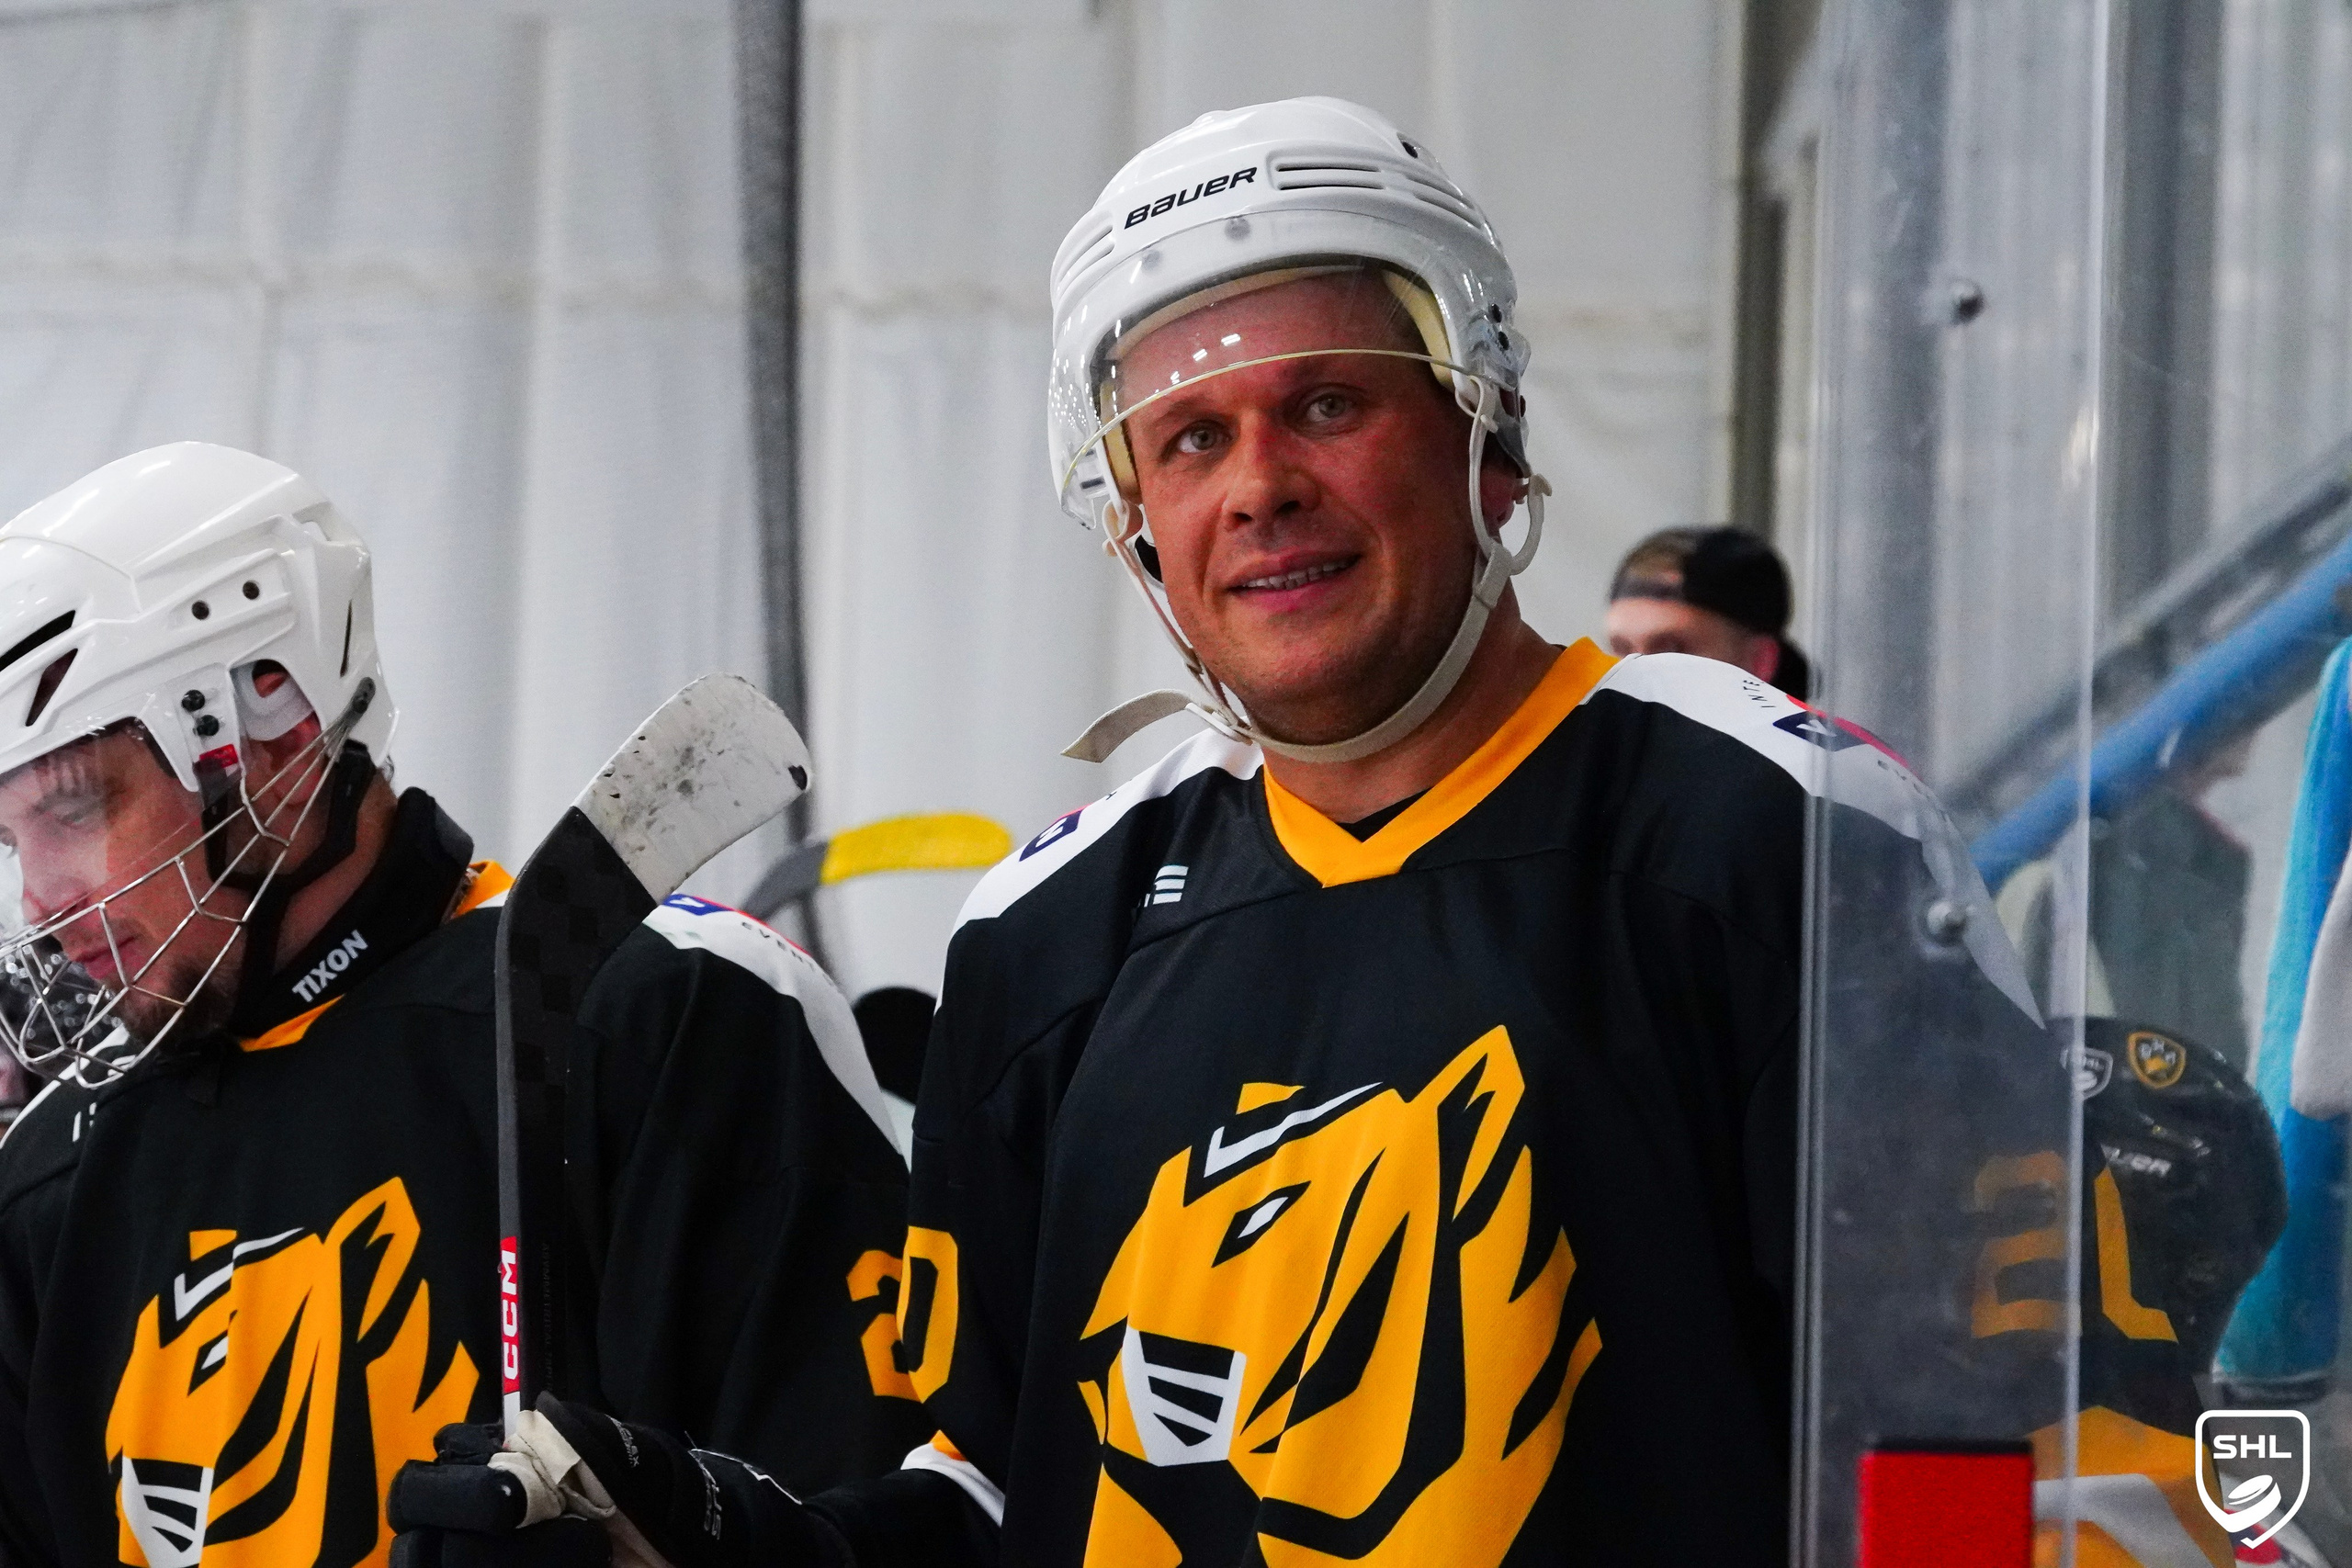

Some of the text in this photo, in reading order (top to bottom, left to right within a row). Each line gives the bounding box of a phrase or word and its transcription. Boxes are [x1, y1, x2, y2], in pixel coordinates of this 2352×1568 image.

[1124, 166, 1258, 230] BAUER
[291, 929, 368, 1003] TIXON
[501, 1249, 519, 1380] CCM
